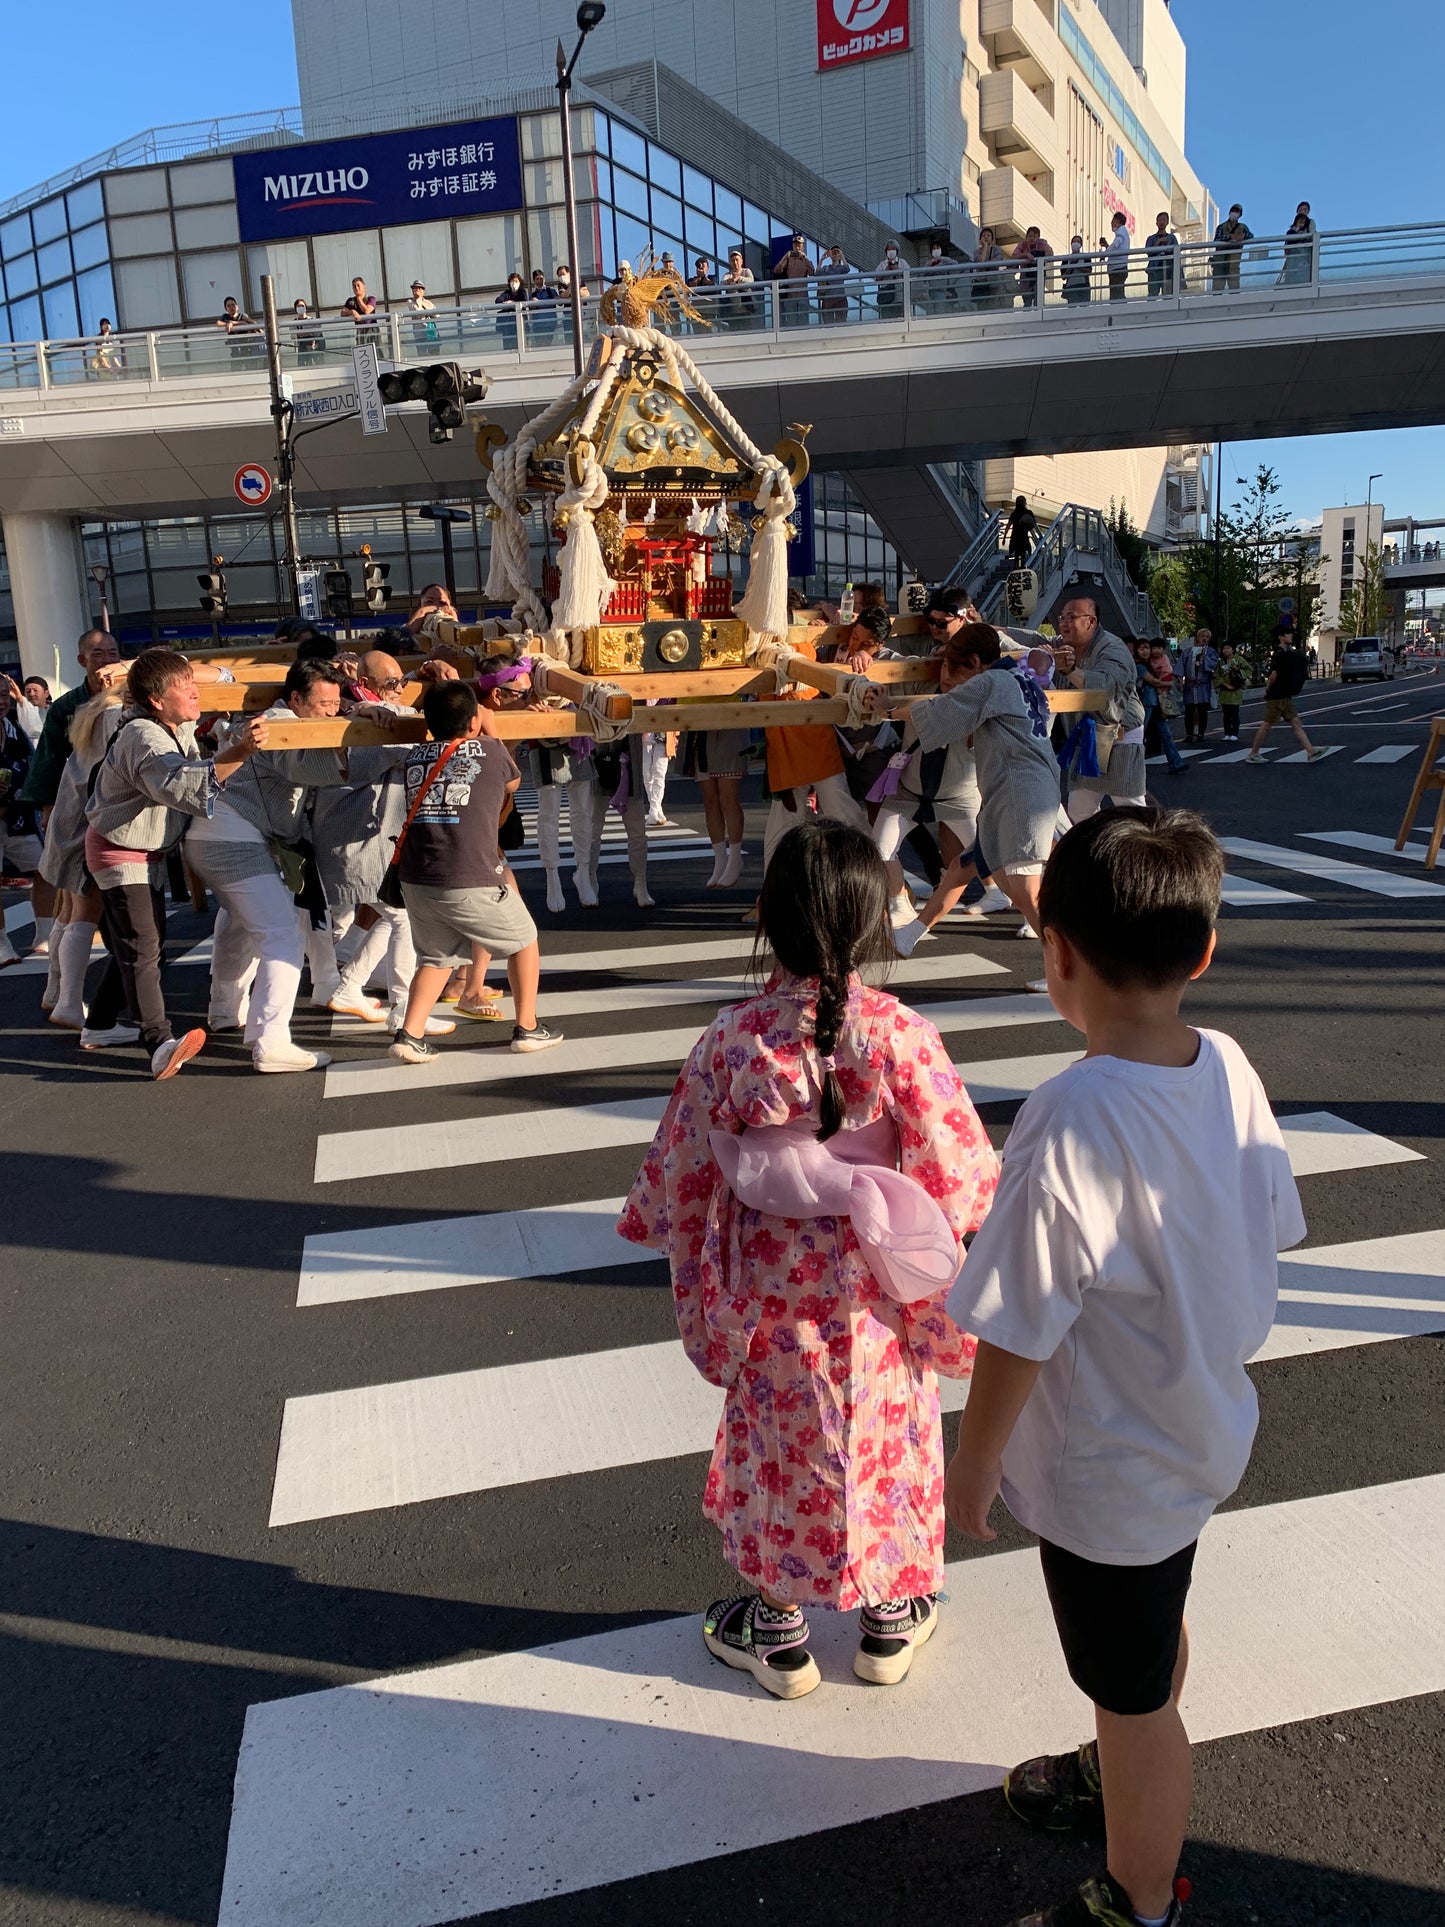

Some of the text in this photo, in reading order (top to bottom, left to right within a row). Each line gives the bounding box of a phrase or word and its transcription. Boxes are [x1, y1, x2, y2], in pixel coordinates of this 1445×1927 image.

[823, 26, 904, 60] ビックカメラ
[408, 142, 495, 171] みずほ銀行
[264, 167, 369, 201] MIZUHO
[410, 170, 497, 199] みずほ証券
[294, 393, 355, 417] 所沢駅西口入口
[359, 349, 379, 430] スクランブル信号
